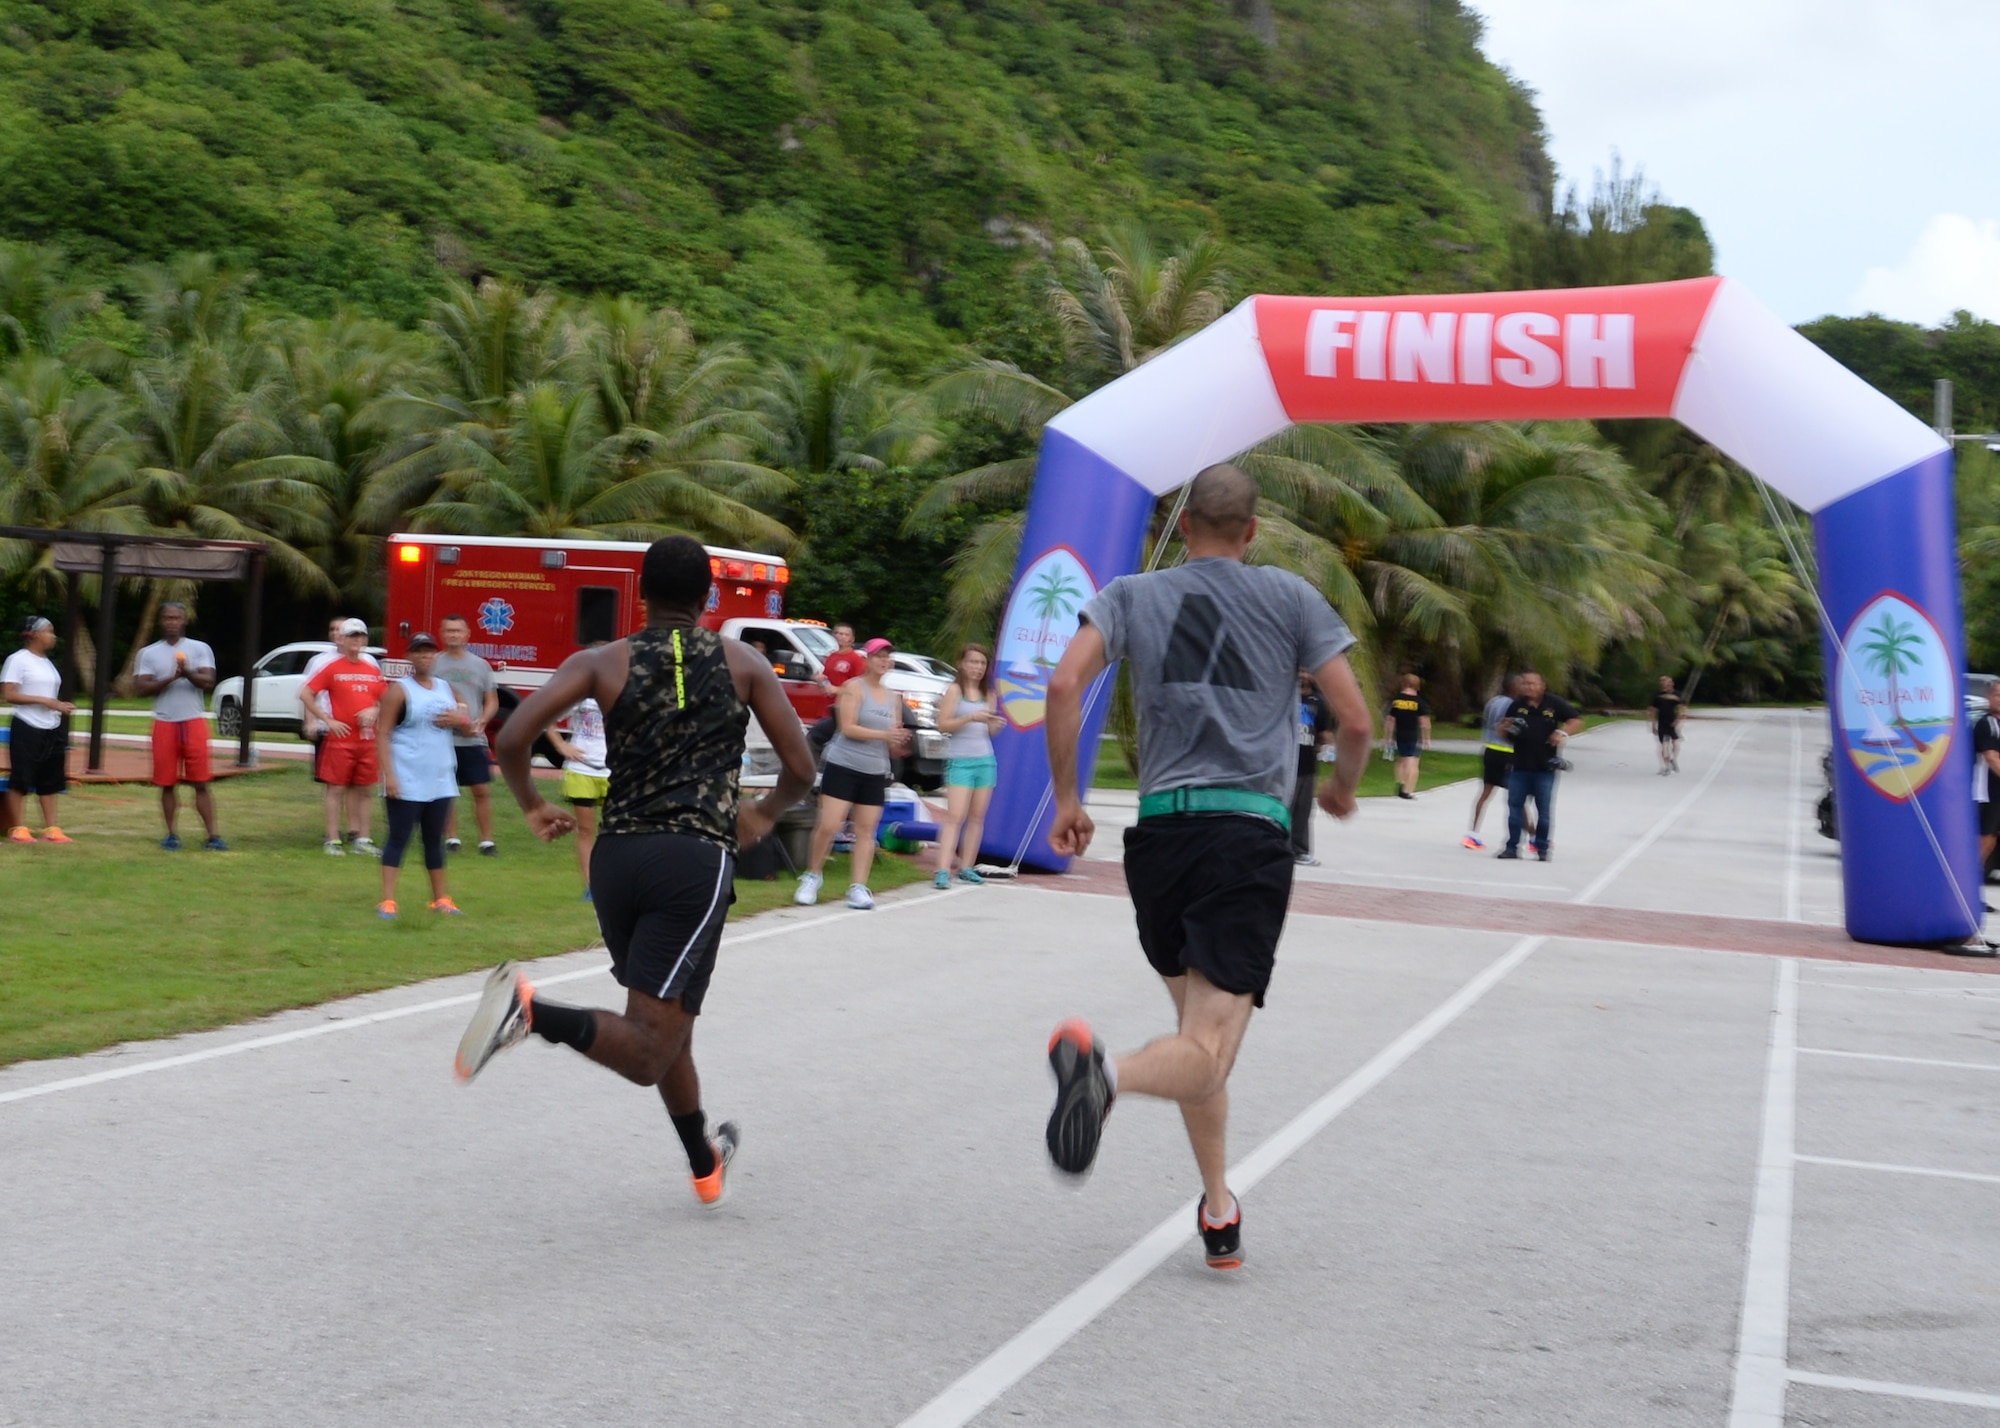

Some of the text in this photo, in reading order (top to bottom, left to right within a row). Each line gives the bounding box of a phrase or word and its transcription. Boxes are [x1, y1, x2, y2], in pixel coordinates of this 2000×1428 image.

[1305, 309, 1635, 389] FINISH
[464, 643, 537, 661] MBULANCE
[672, 629, 685, 709] UNDER ARMOUR
[1857, 686, 1934, 705] GUAM
